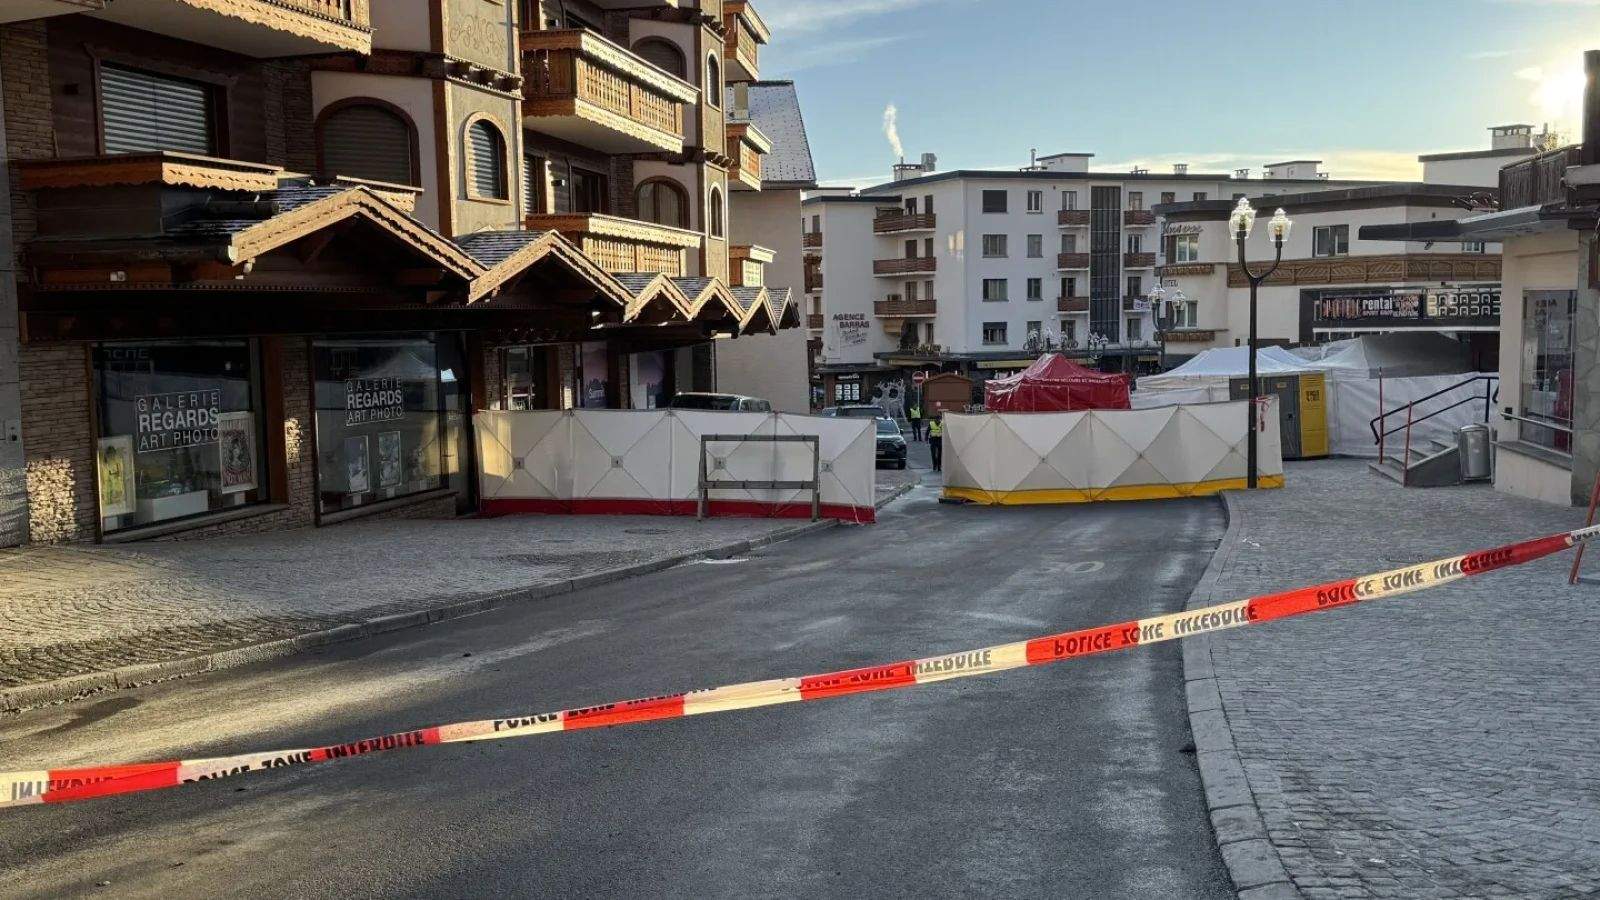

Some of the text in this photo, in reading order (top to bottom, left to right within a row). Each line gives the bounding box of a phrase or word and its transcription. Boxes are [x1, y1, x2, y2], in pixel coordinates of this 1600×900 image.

[1362, 297, 1392, 310] rental
[346, 377, 402, 392] GALERIE
[137, 391, 219, 412] GALERIE
[347, 390, 402, 410] REGARDS
[138, 407, 219, 433] REGARDS
[348, 406, 403, 423] ART PHOTO
[140, 428, 219, 449] ART PHOTO
